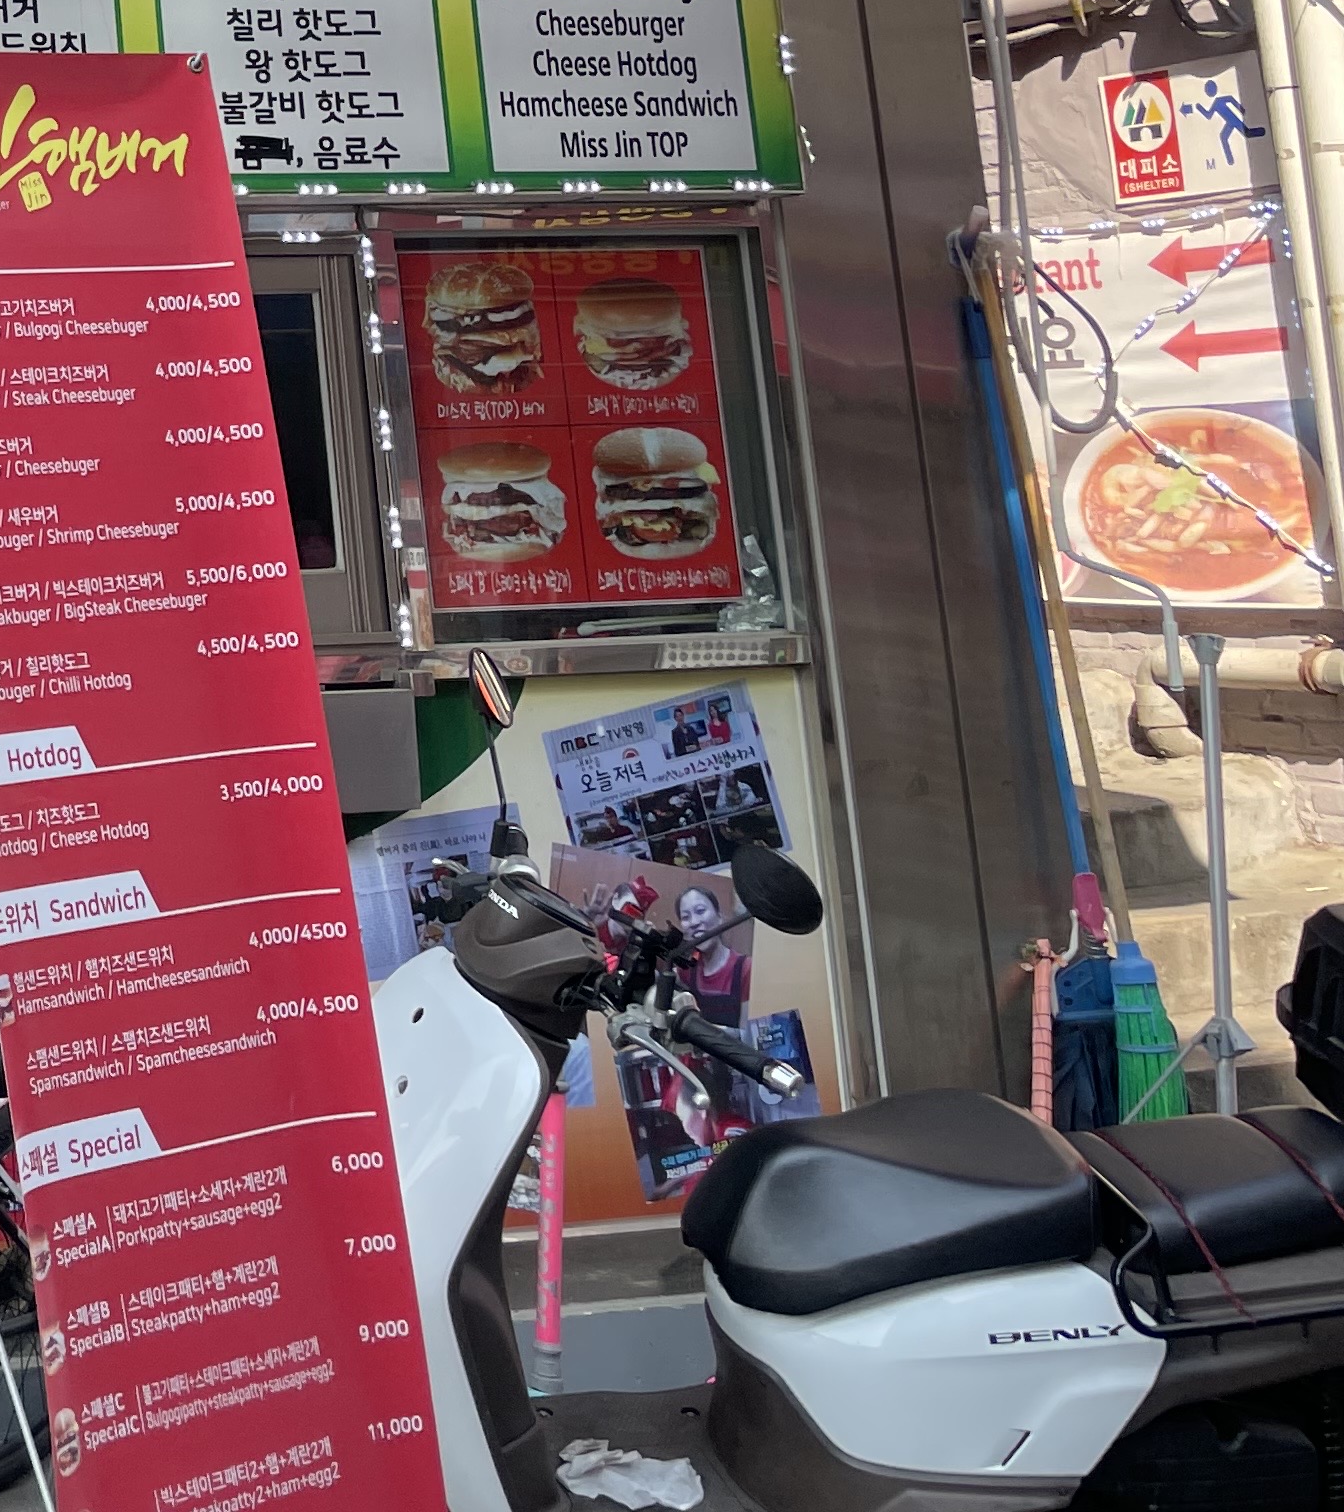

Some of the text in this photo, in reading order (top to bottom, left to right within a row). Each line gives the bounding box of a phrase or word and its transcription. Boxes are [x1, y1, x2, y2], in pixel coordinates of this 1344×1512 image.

[226, 8, 380, 41] 칠리 핫도그
[535, 10, 685, 42] Cheeseburger
[245, 50, 370, 82] 왕 핫도그
[533, 51, 696, 83] Cheese Hotdog
[219, 91, 403, 125] 불갈비 핫도그
[501, 92, 737, 118] Hamcheese Sandwich
[313, 136, 400, 166] 음료수
[561, 132, 688, 159] Miss Jin TOP
[1120, 154, 1180, 179] 대피소
[1125, 177, 1179, 193] (SHELTER)
[146, 292, 240, 313] 4,000/4,500
[14, 322, 63, 338] Bulgogi
[10, 365, 109, 385] 스테이크치즈버거
[156, 357, 252, 378] 4,000/4,500
[12, 392, 49, 406] Steak
[166, 424, 263, 446] 4,000/4,500
[7, 505, 59, 526] 새우버거
[176, 490, 275, 514] 5,000/4,500
[47, 528, 94, 546] Shrimp
[186, 562, 287, 586] 5,500/6,000
[198, 632, 299, 657] 4,500/4,500
[49, 673, 132, 693] Chilli Hotdog
[8, 744, 82, 772] Hotdog
[37, 775, 323, 827] 치즈핫도그 3,500/4,000
[51, 831, 98, 848] Cheese
[101, 821, 149, 842] Hotdog
[50, 887, 146, 923] Sandwich
[68, 1124, 141, 1168] Special
[332, 1152, 383, 1174] 6,000
[344, 1234, 396, 1257] 7,000
[359, 1319, 409, 1342] 9,000
[989, 1324, 1124, 1345] BENLY
[367, 1415, 423, 1441] 11,000
